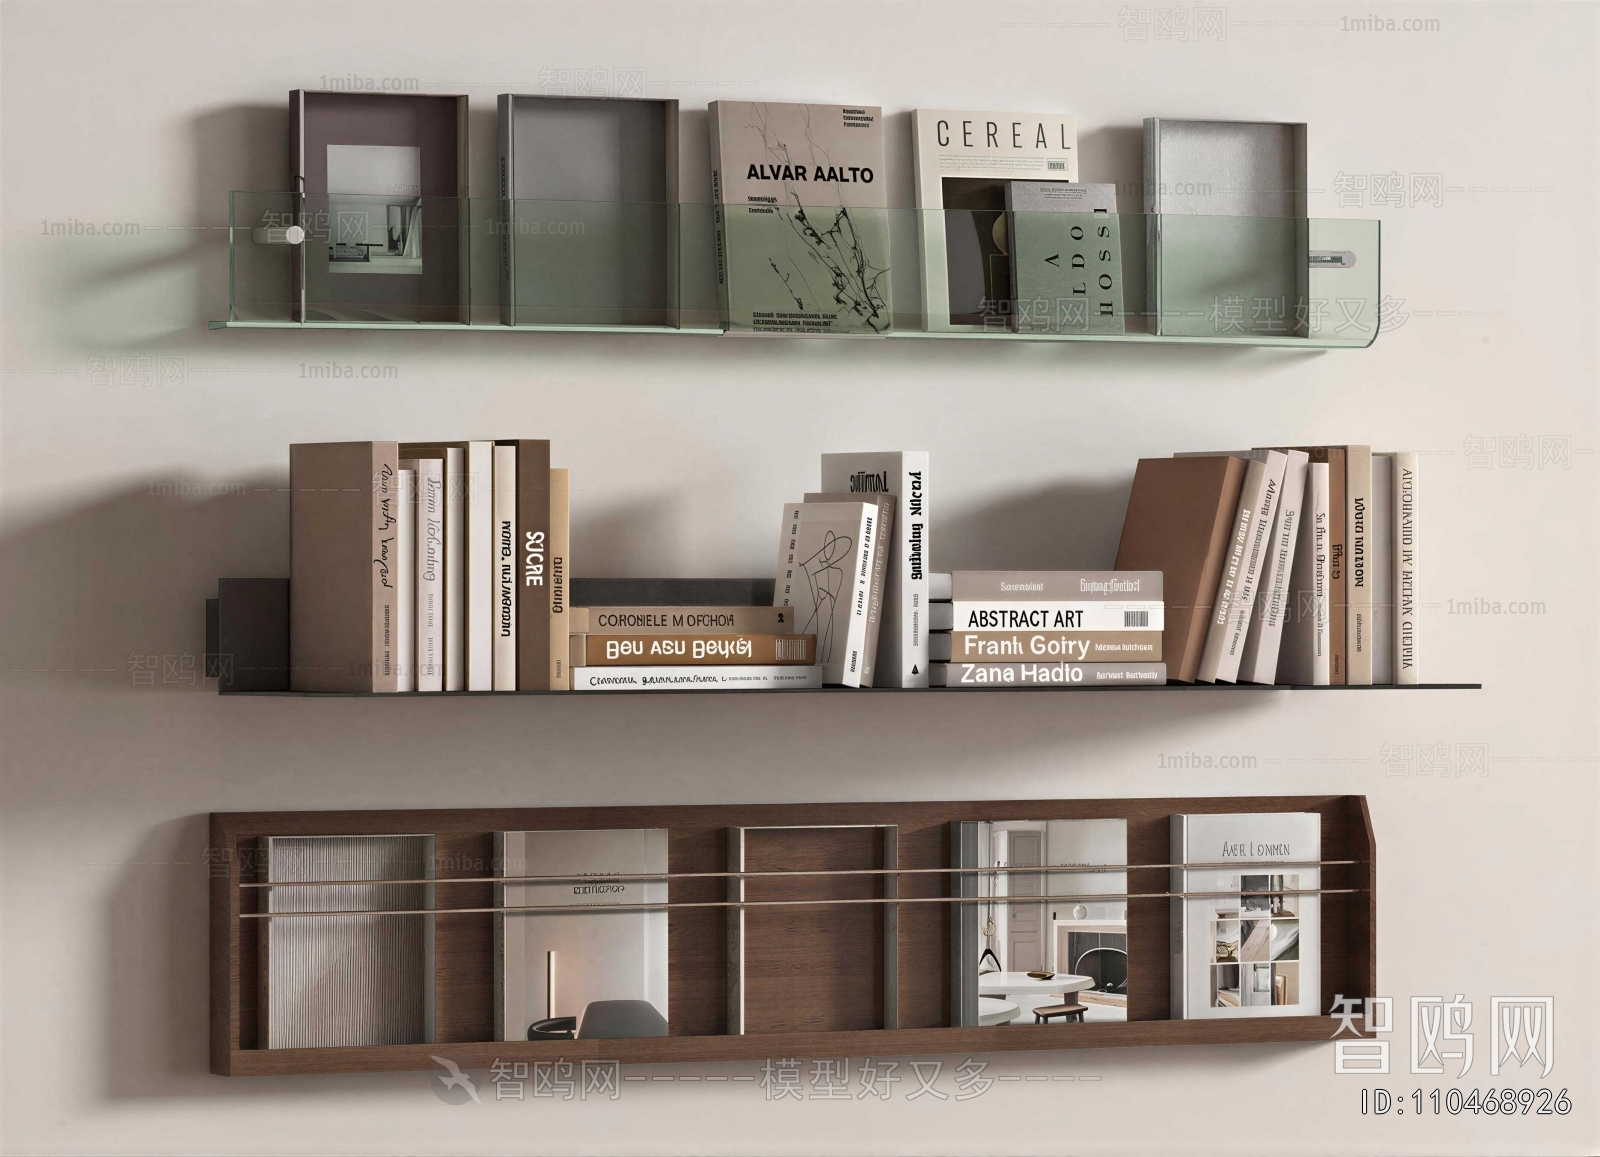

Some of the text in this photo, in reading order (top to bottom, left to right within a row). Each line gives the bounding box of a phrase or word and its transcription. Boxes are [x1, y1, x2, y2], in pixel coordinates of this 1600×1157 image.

[937, 119, 1071, 150] CEREAL
[747, 164, 874, 184] ALVAR AALTO
[968, 610, 1084, 628] ABSTRACT ART
